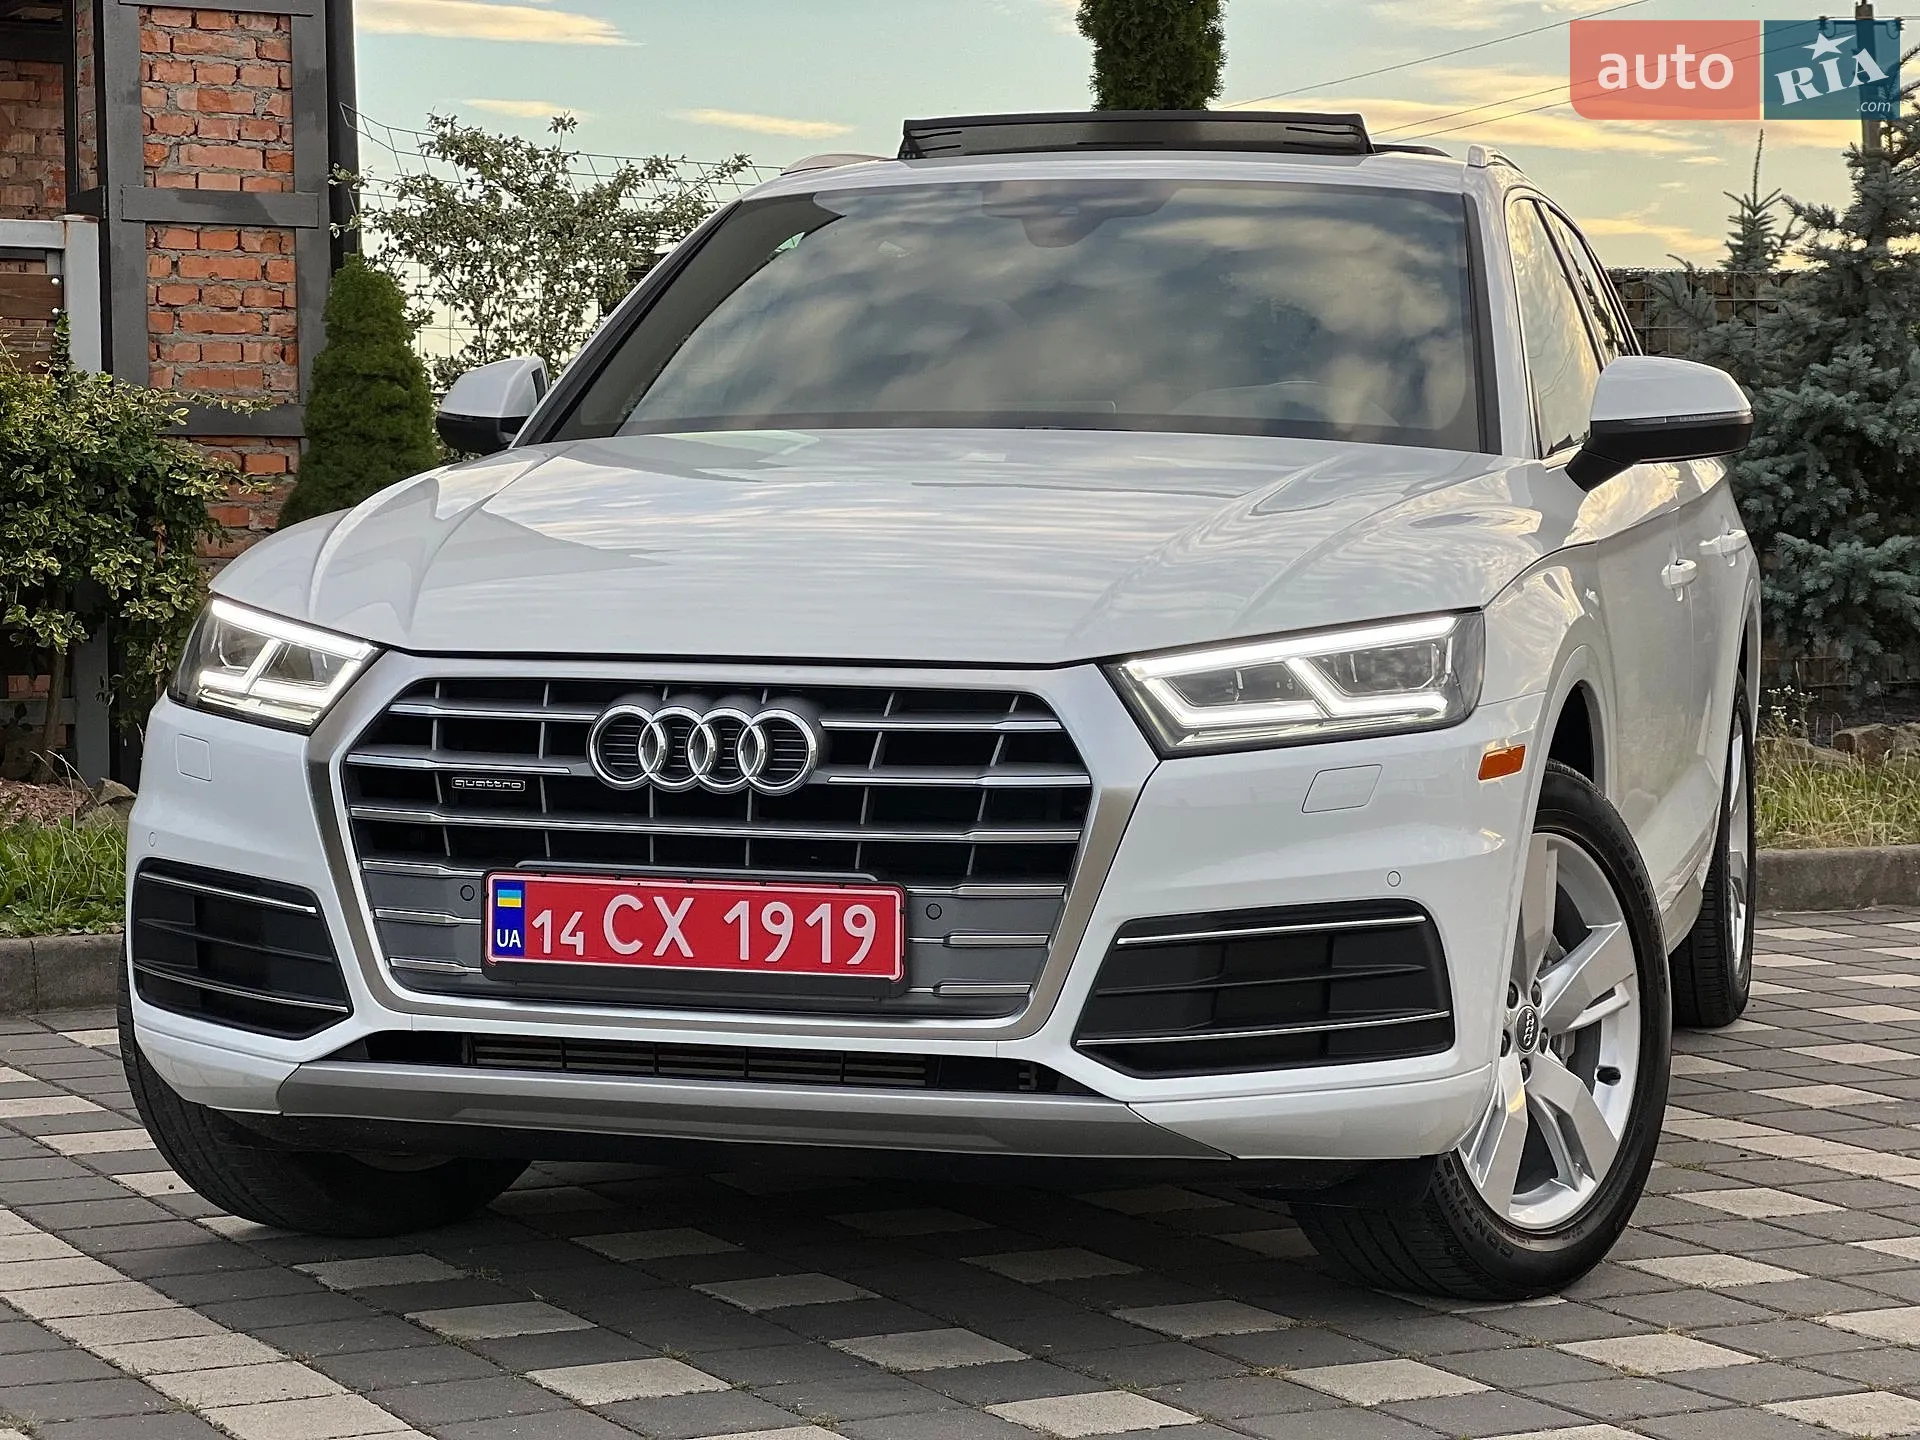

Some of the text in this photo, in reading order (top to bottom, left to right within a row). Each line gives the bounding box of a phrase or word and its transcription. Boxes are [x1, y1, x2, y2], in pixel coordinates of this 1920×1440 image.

[454, 779, 522, 789] quattro
[496, 928, 522, 949] UA
[531, 893, 877, 966] 14 CX 1919
